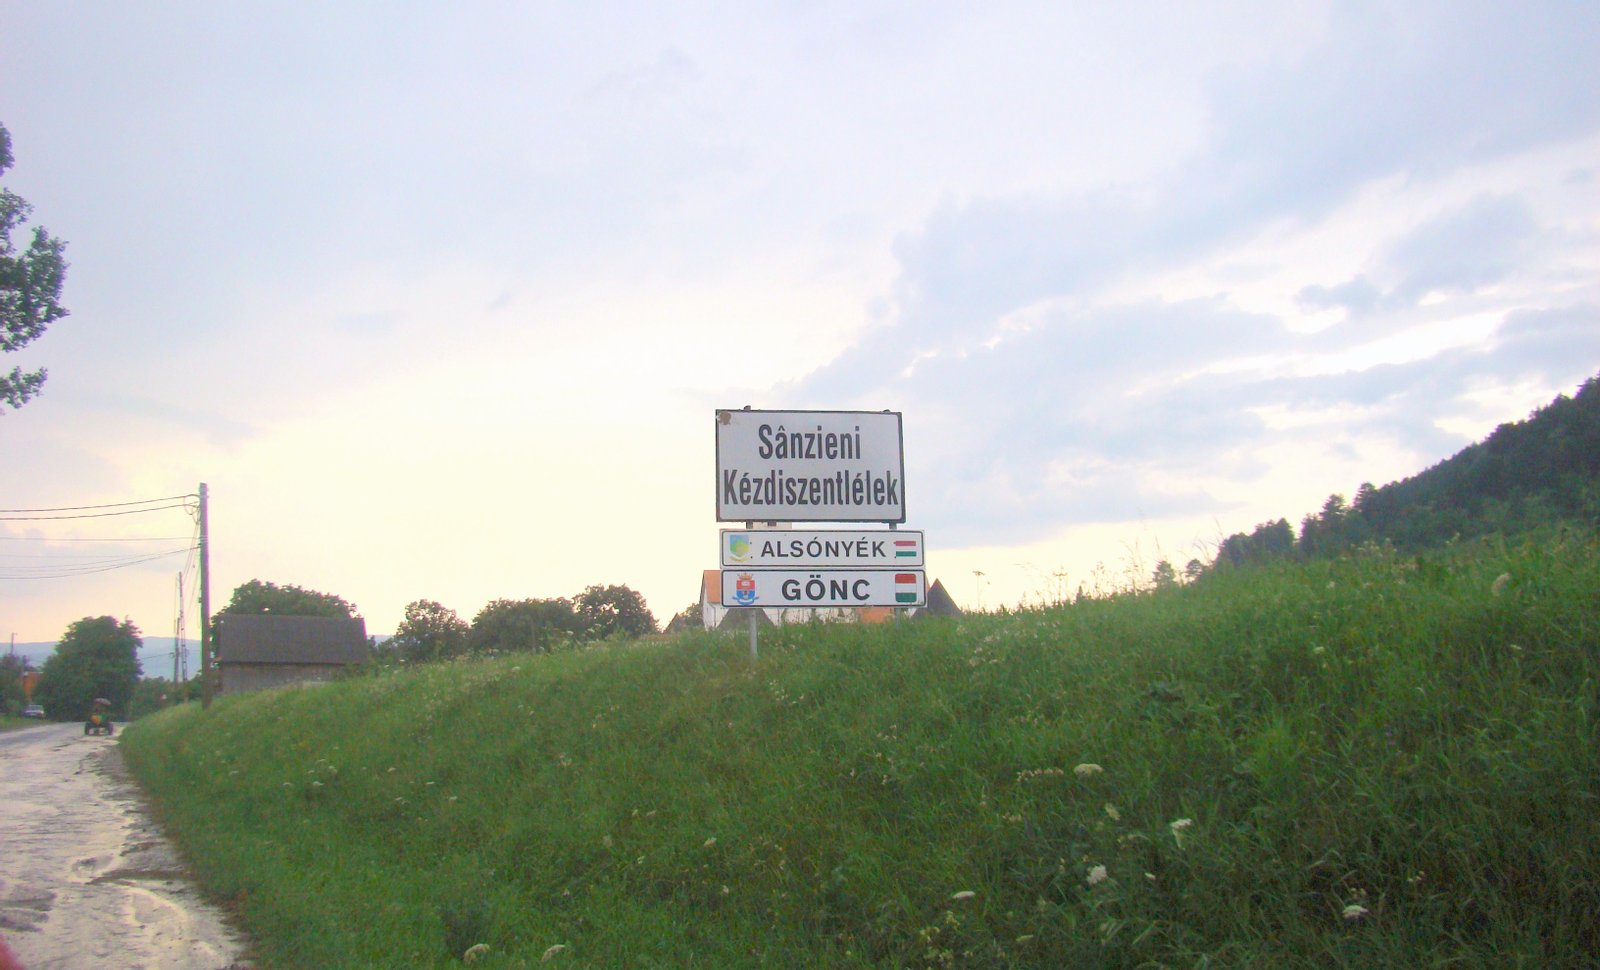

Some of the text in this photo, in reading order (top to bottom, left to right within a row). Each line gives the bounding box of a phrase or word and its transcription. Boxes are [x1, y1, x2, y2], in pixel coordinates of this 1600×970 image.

[758, 424, 861, 459] Sânzieni
[723, 469, 899, 505] Kézdiszentlélek
[760, 536, 887, 558] ALSÓNYÉK
[781, 574, 871, 601] GÖNC
